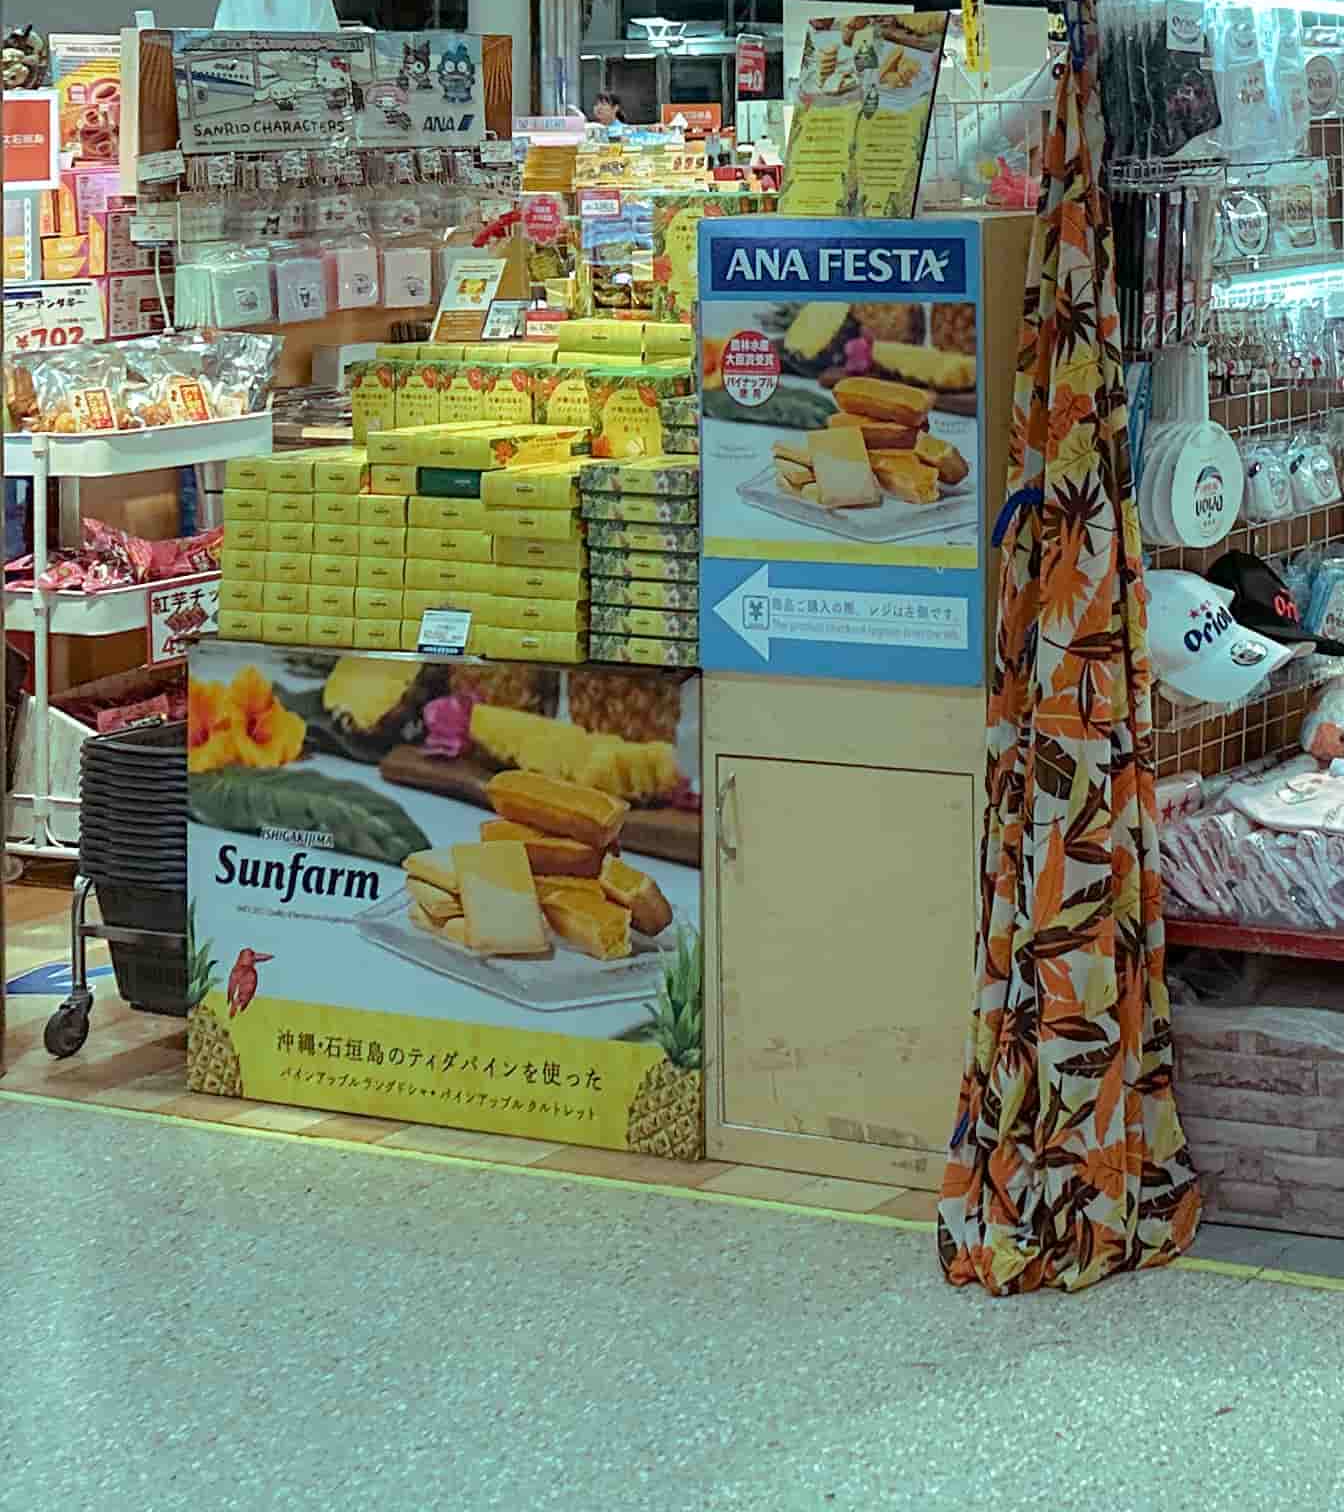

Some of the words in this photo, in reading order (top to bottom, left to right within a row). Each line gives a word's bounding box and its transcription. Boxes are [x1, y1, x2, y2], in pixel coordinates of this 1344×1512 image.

[424, 116, 455, 131] ANA
[726, 248, 810, 281] ANA
[819, 248, 949, 282] FESTA
[215, 844, 380, 903] Sunfarm
